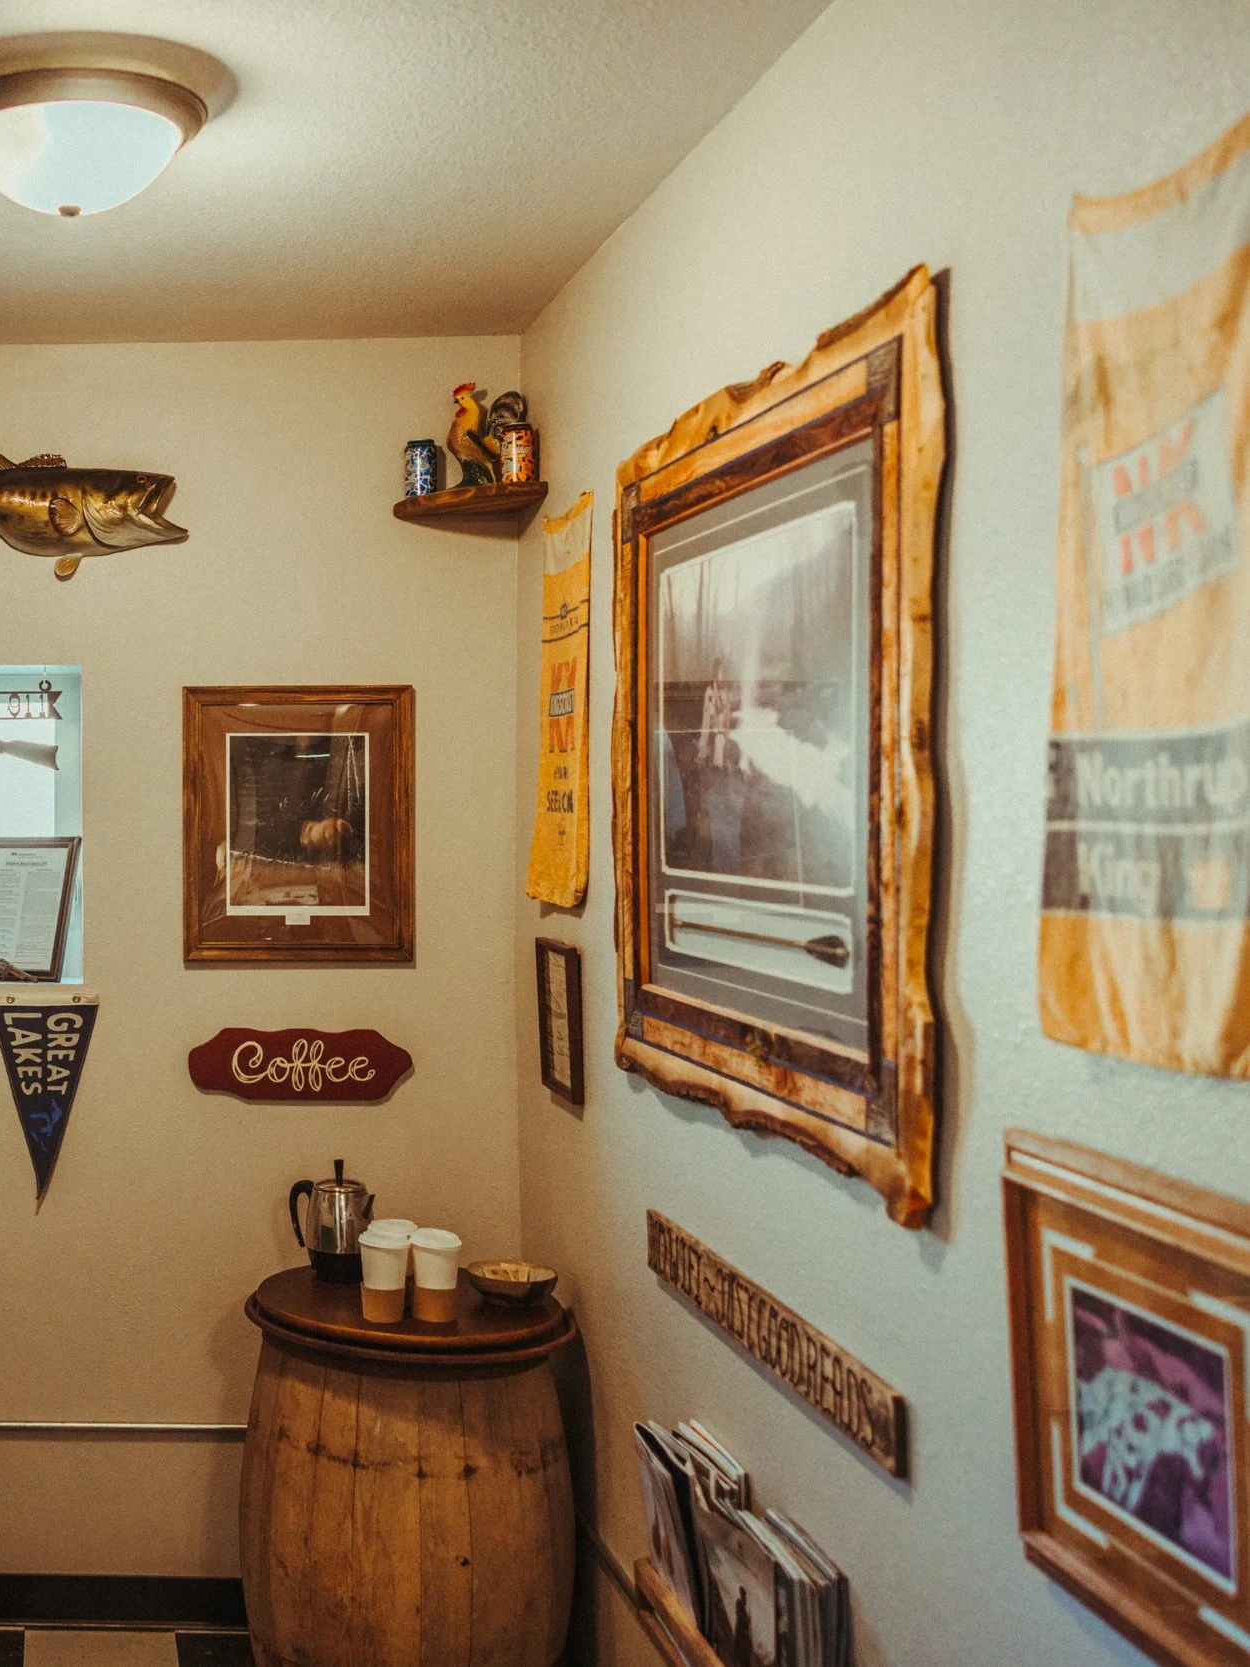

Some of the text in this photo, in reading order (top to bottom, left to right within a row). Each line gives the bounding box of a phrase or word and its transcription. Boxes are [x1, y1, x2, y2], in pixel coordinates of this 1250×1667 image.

[7, 692, 47, 720] 911
[1075, 750, 1247, 812] Northrup
[1077, 841, 1161, 916] King
[3, 1012, 43, 1096] LAKES
[46, 1012, 84, 1095] GREAT
[232, 1039, 375, 1092] Coffee
[715, 1267, 753, 1354] JUST
[757, 1298, 801, 1386] GOOD
[803, 1335, 875, 1450] READS
